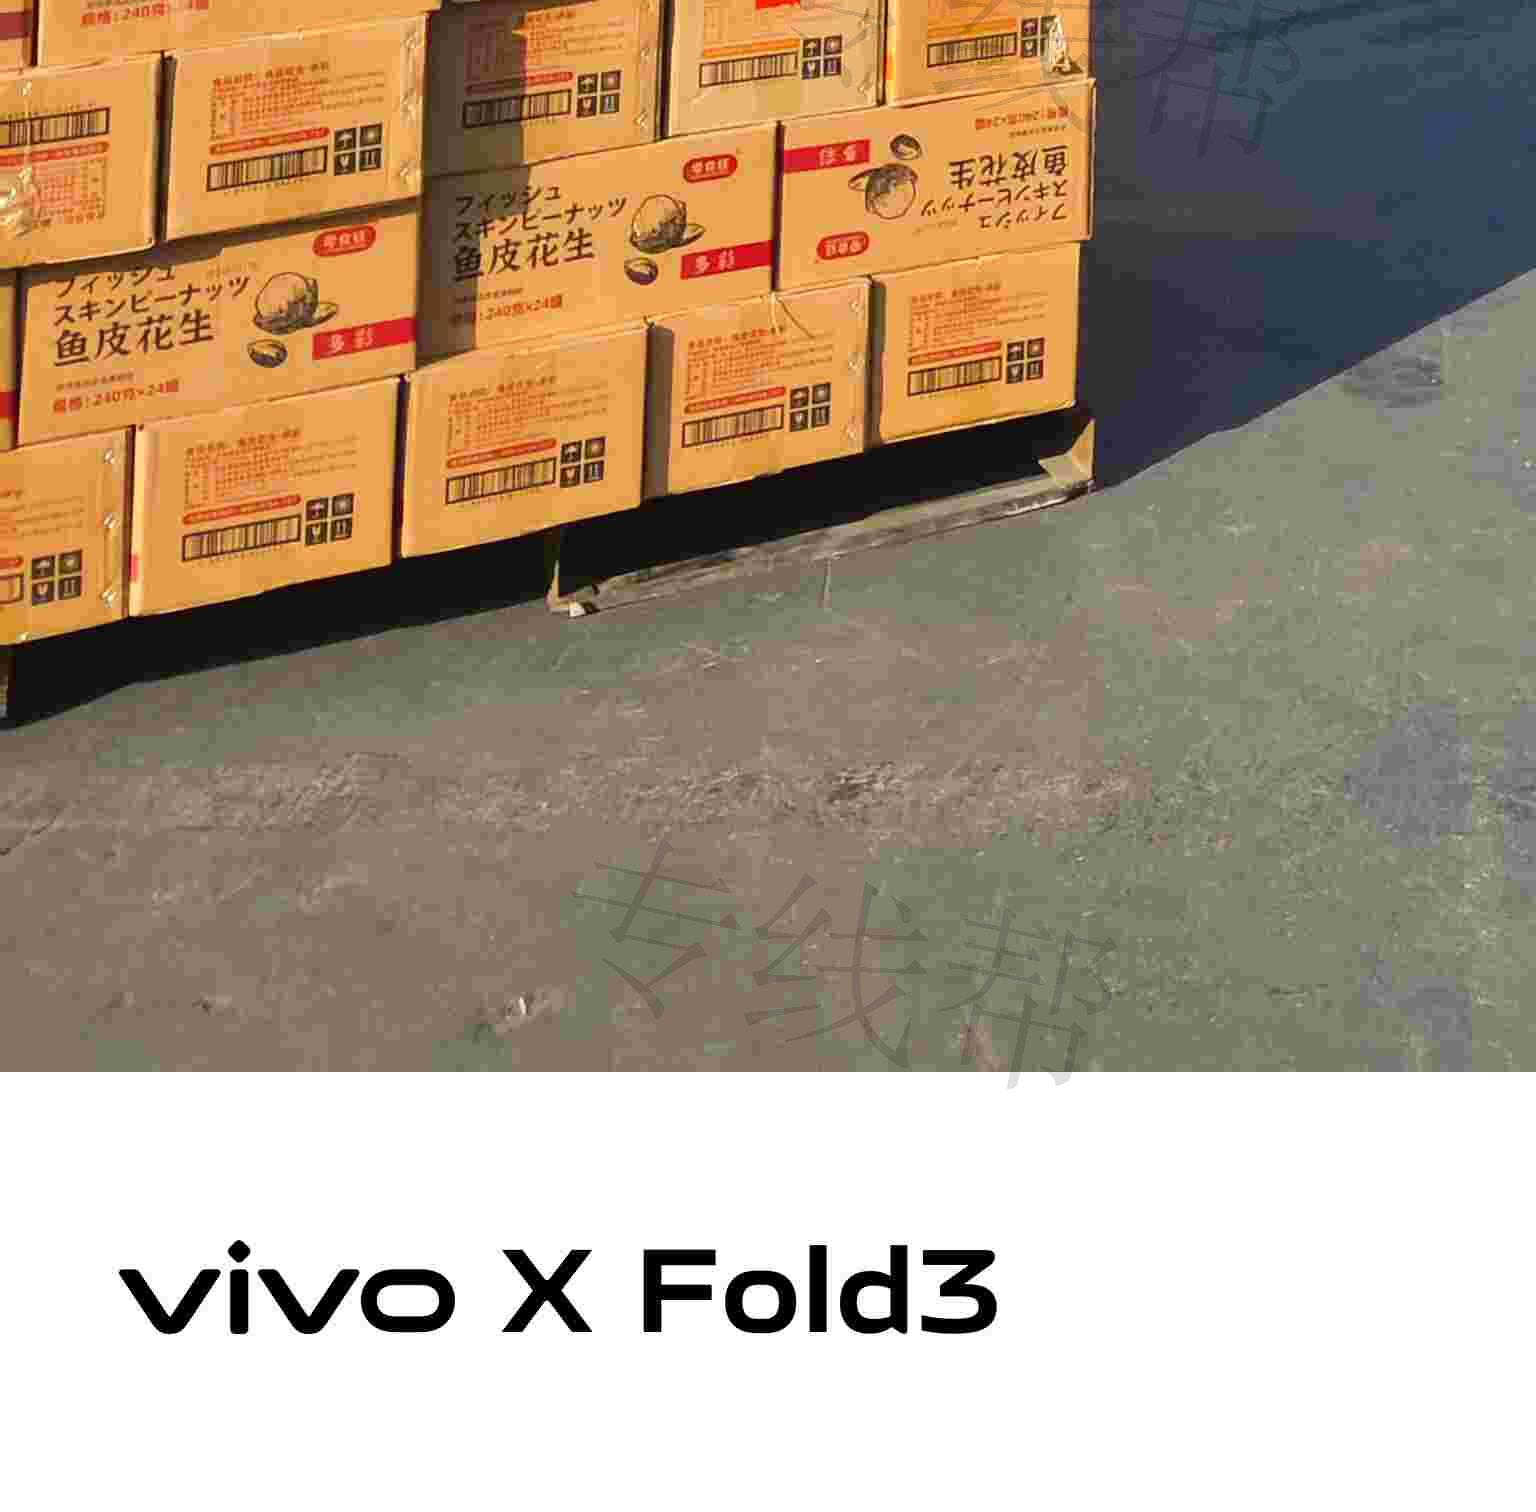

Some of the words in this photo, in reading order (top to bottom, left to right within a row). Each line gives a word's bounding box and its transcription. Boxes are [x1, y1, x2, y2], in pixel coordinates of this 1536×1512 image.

[949, 144, 1069, 190] 鱼皮花生
[452, 227, 595, 283] 鱼皮花生
[52, 308, 216, 368] 鱼皮花生
